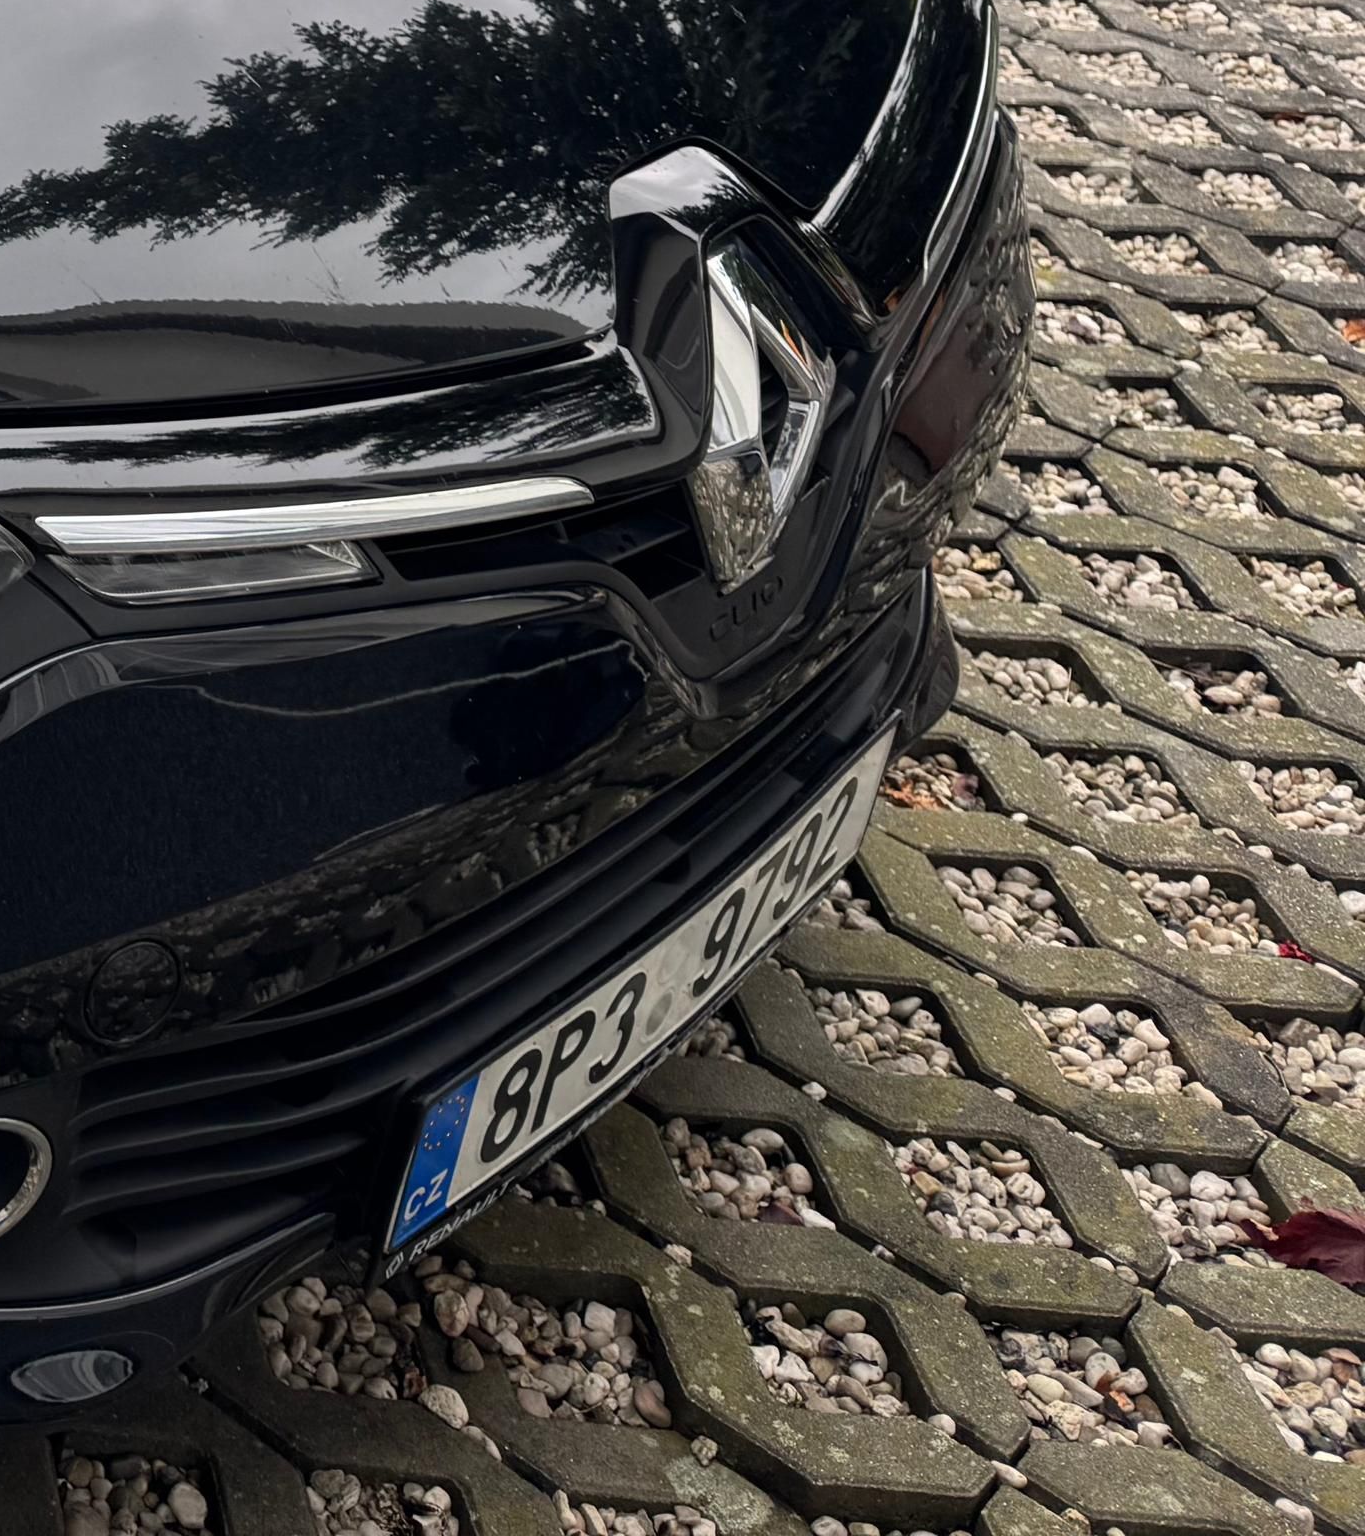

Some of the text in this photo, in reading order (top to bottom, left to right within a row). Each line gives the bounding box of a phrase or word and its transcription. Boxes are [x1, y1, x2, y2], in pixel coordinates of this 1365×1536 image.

[709, 575, 783, 642] CLIO
[480, 971, 647, 1163] 8P3
[692, 776, 859, 997] 9792
[403, 1168, 448, 1222] CZ
[409, 1176, 515, 1261] RENAULT
